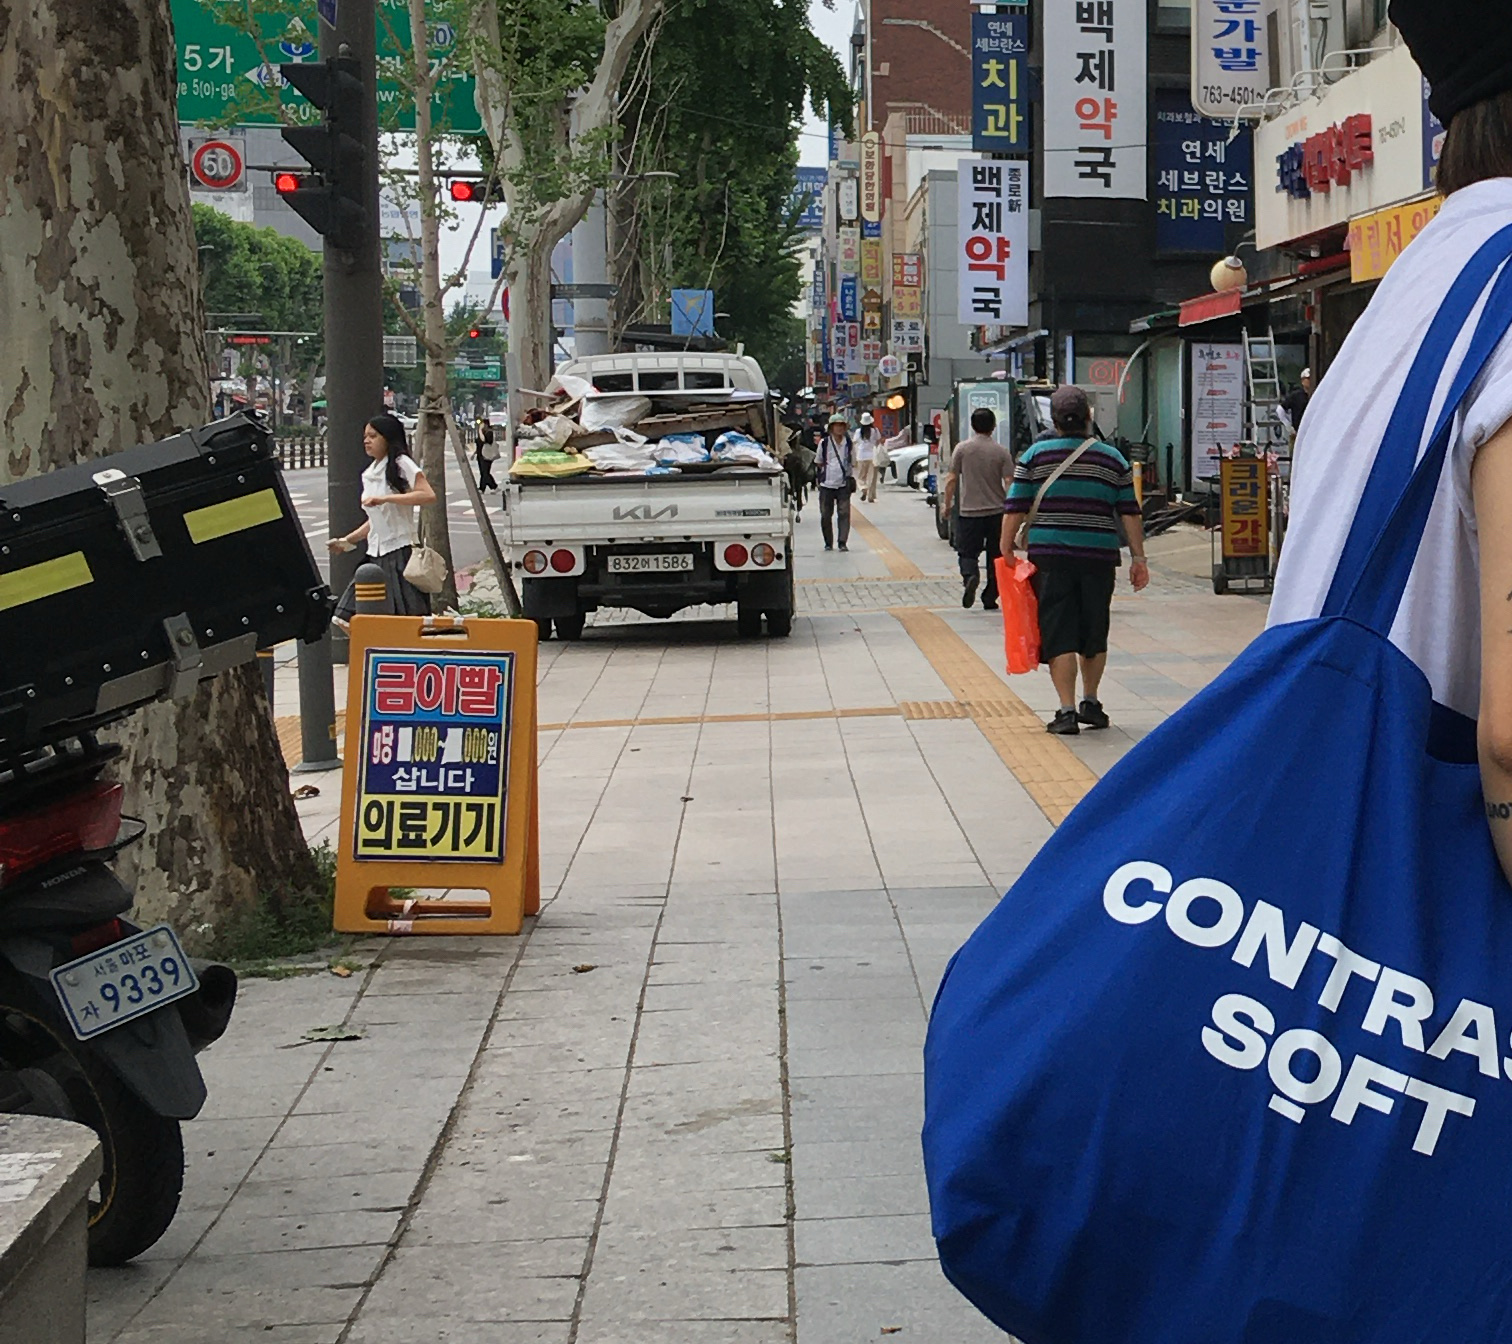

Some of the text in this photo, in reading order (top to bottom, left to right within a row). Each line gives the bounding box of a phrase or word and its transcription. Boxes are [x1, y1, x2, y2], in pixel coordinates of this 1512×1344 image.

[987, 21, 1013, 37] 연세
[975, 37, 1026, 54] 세브란스
[980, 58, 1023, 144] 치과
[1202, 85, 1271, 105] 763-4501~
[1182, 140, 1226, 163] 연세
[203, 154, 232, 176] 50
[1157, 169, 1248, 194] 세브란스
[1157, 198, 1246, 222] 치과의원
[965, 166, 1011, 320] 백제약국
[375, 663, 503, 716] 금이빨
[391, 767, 475, 793] 삽니다
[361, 799, 495, 853] 의료기기
[41, 866, 88, 889] HONDA
[94, 943, 152, 978] 서울 마포
[80, 957, 181, 1021] 자 9339
[1201, 993, 1476, 1155] SOFT
